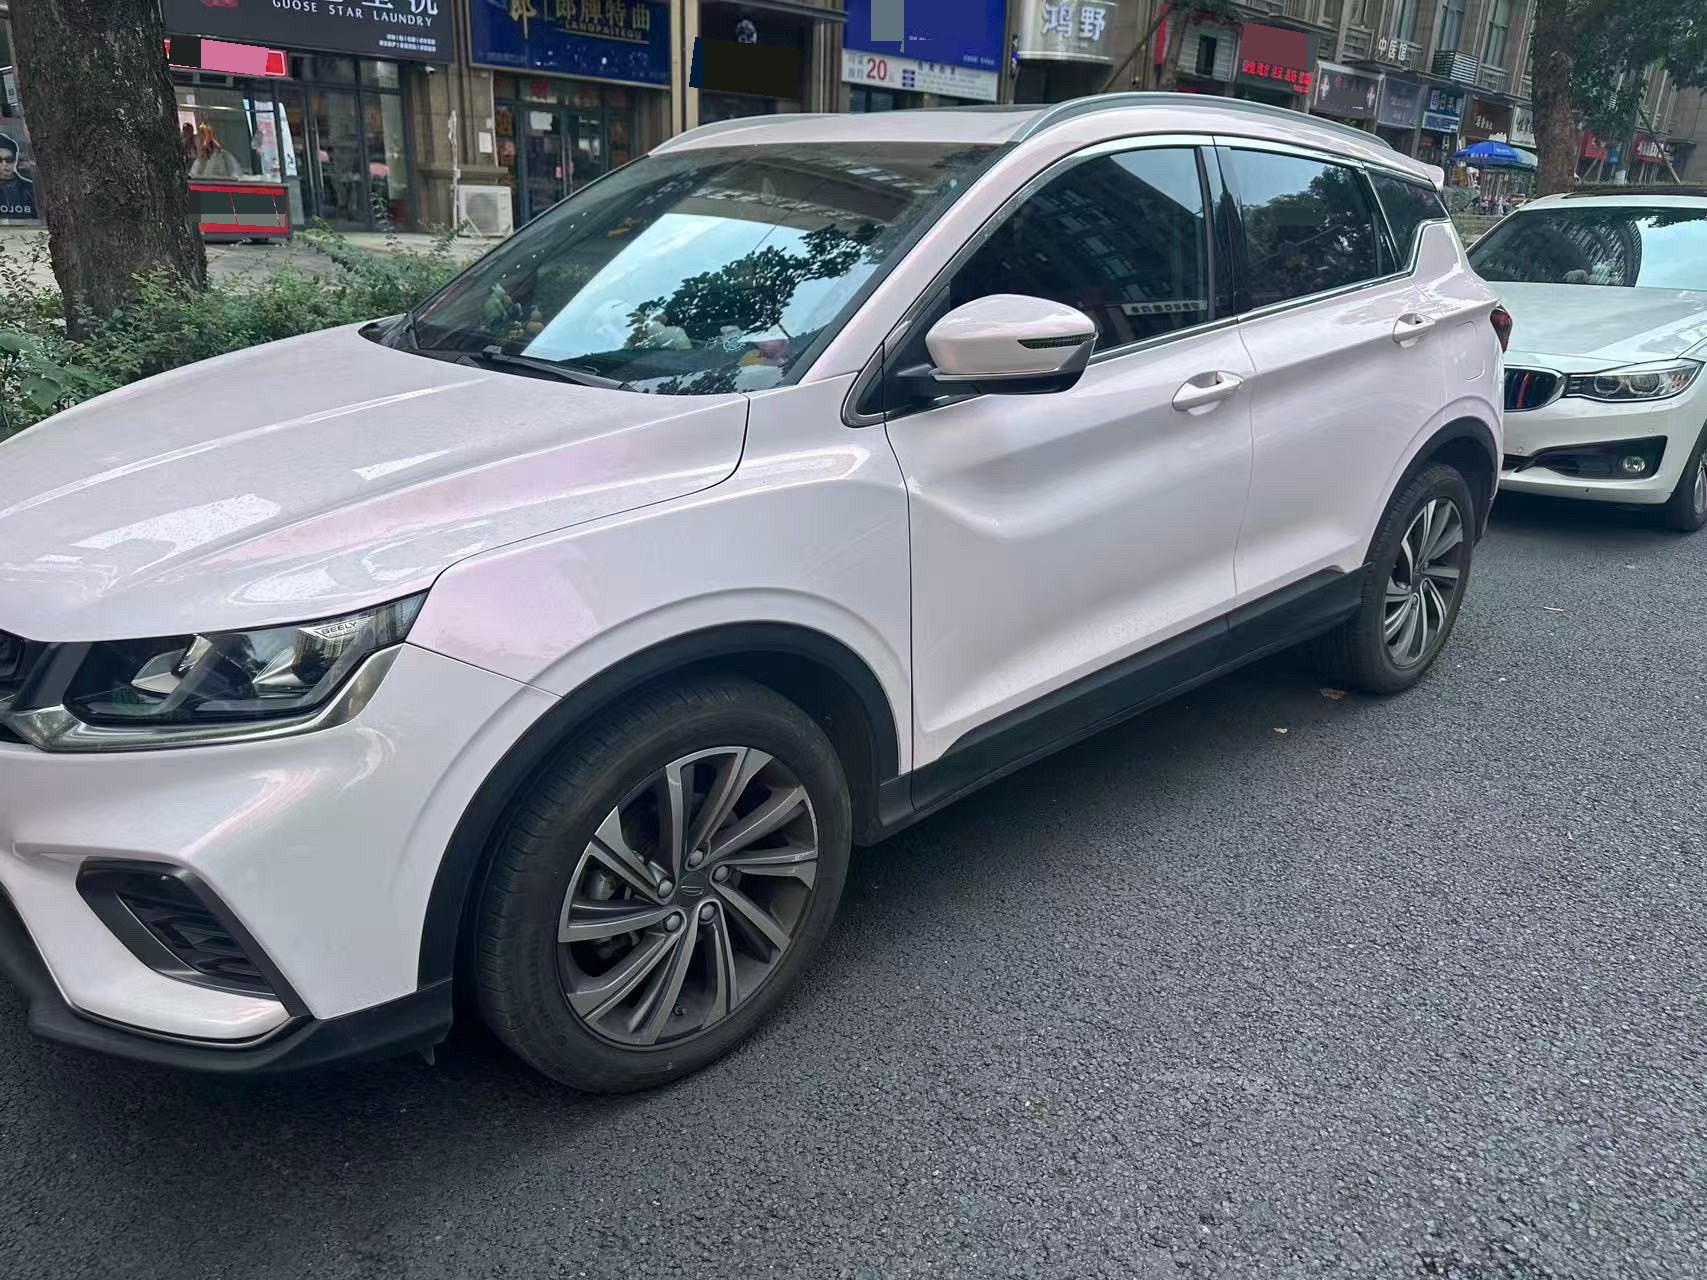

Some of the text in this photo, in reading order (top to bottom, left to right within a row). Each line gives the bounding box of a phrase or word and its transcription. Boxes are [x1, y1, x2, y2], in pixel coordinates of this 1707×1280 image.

[328, 4, 363, 19] STAR
[373, 10, 432, 27] LAUNDRY
[1041, 0, 1106, 41] 鸿野
[866, 58, 887, 81] 20
[321, 621, 357, 635] GEELY
